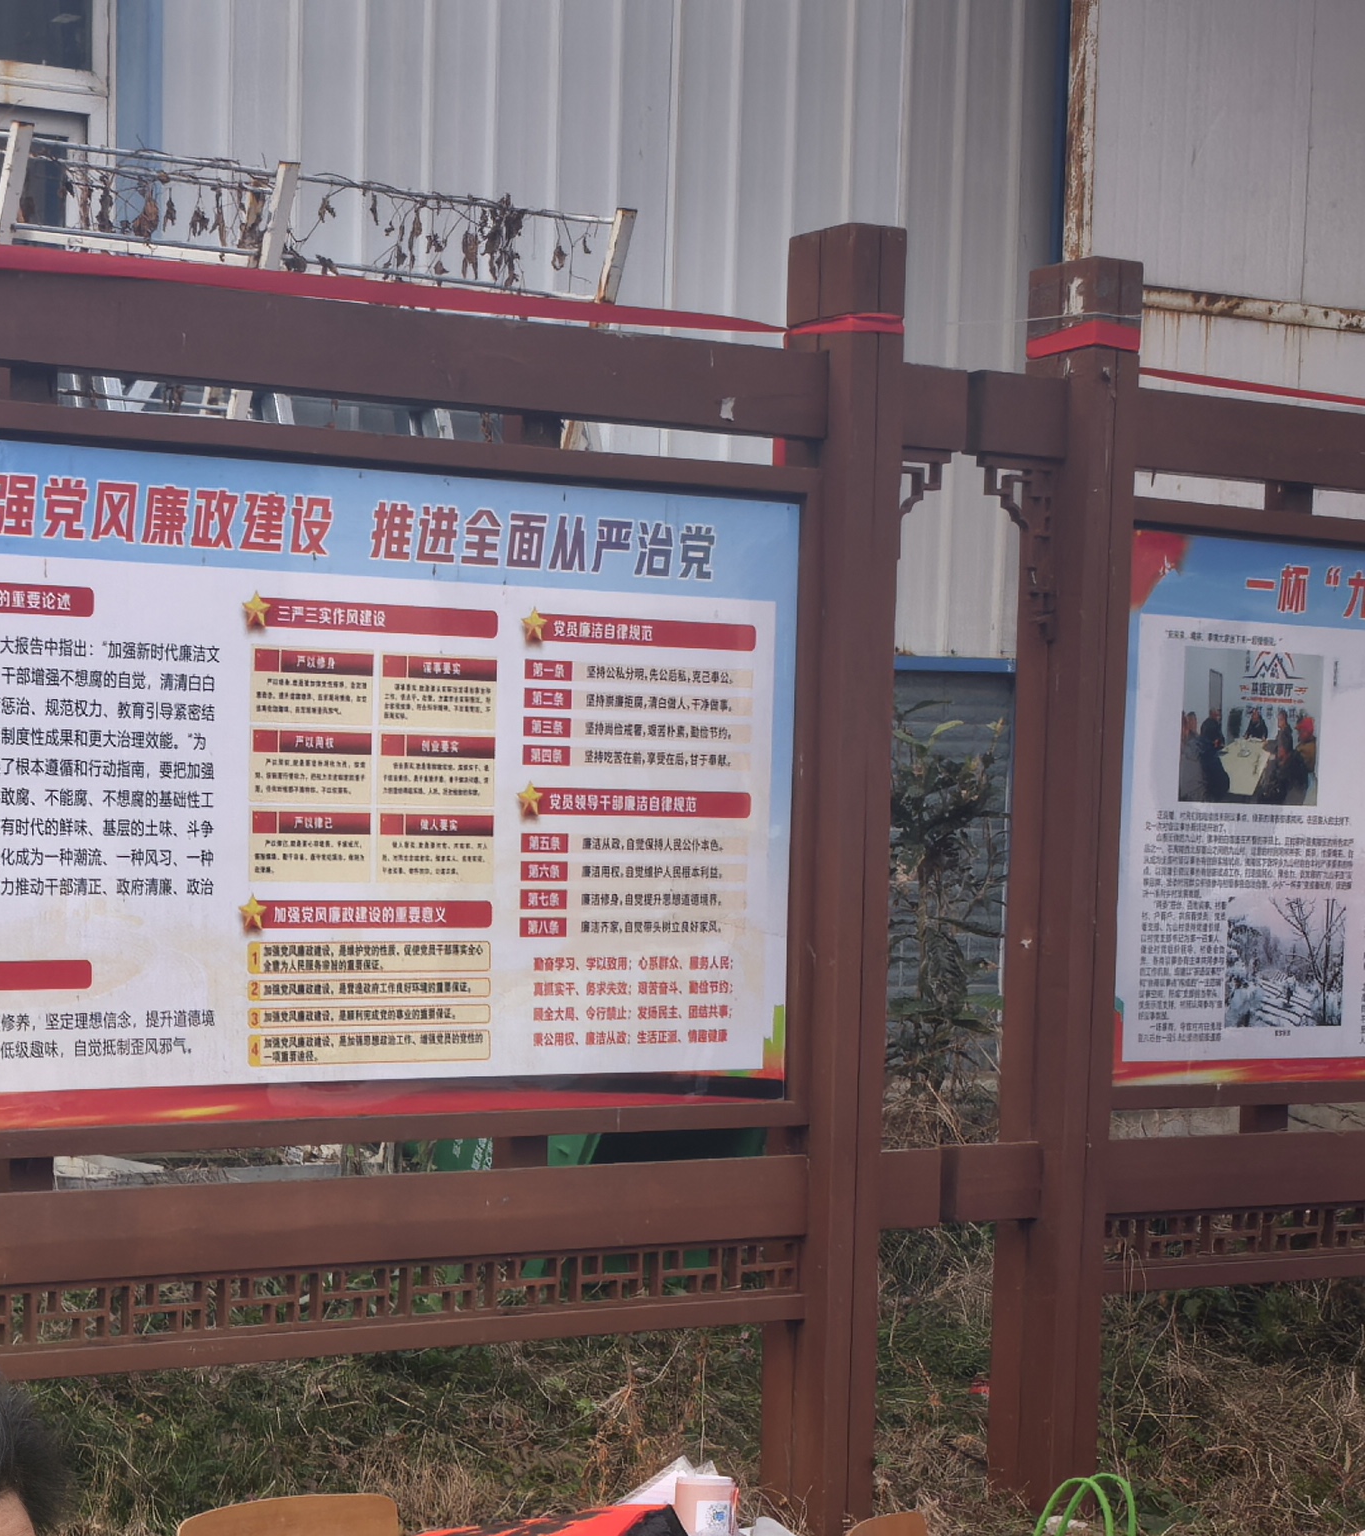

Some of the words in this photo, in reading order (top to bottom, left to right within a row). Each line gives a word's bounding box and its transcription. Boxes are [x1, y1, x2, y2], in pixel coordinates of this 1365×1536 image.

[368, 499, 716, 582] 推进全面从严治党
[277, 605, 386, 628] 三严三实作风建设
[553, 620, 653, 641] 党员廉洁自律规范
[532, 661, 564, 678] 第一条
[532, 691, 564, 706] 第二条
[531, 719, 563, 735] 第三条
[531, 748, 562, 763] 第四条
[549, 793, 697, 812] 党员领导干部廉洁自律规范
[529, 836, 561, 850] 第五条
[528, 864, 560, 878] 第六条
[528, 892, 560, 907] 第七条
[274, 906, 447, 924] 加强党风廉政建设的重要意义
[528, 920, 559, 935] 第八条
[251, 983, 259, 996] 2
[251, 1011, 259, 1025] 3
[250, 1042, 259, 1056] 4
